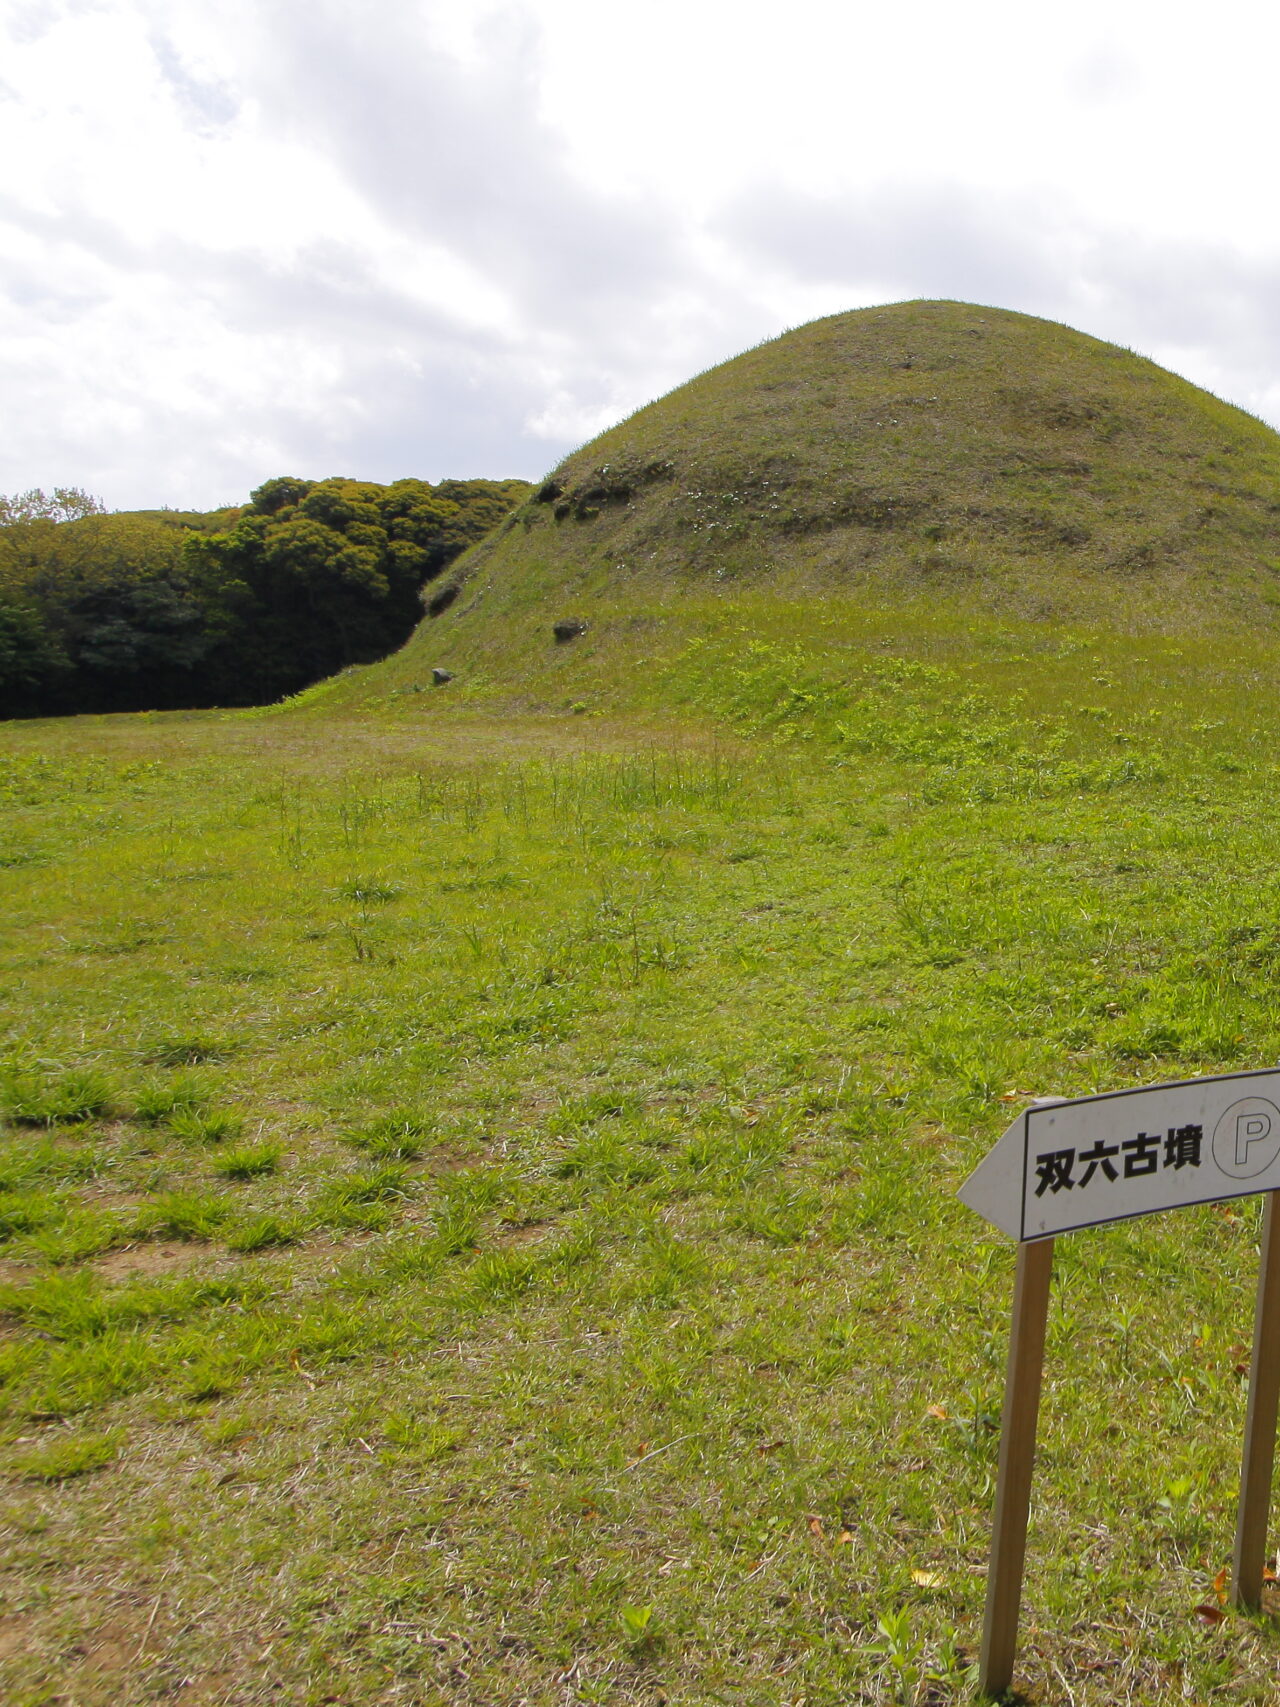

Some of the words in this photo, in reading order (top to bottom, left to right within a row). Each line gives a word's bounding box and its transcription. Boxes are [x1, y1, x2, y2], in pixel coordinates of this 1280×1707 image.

[1033, 1123, 1204, 1198] 双六古墳
[1234, 1112, 1272, 1166] P
